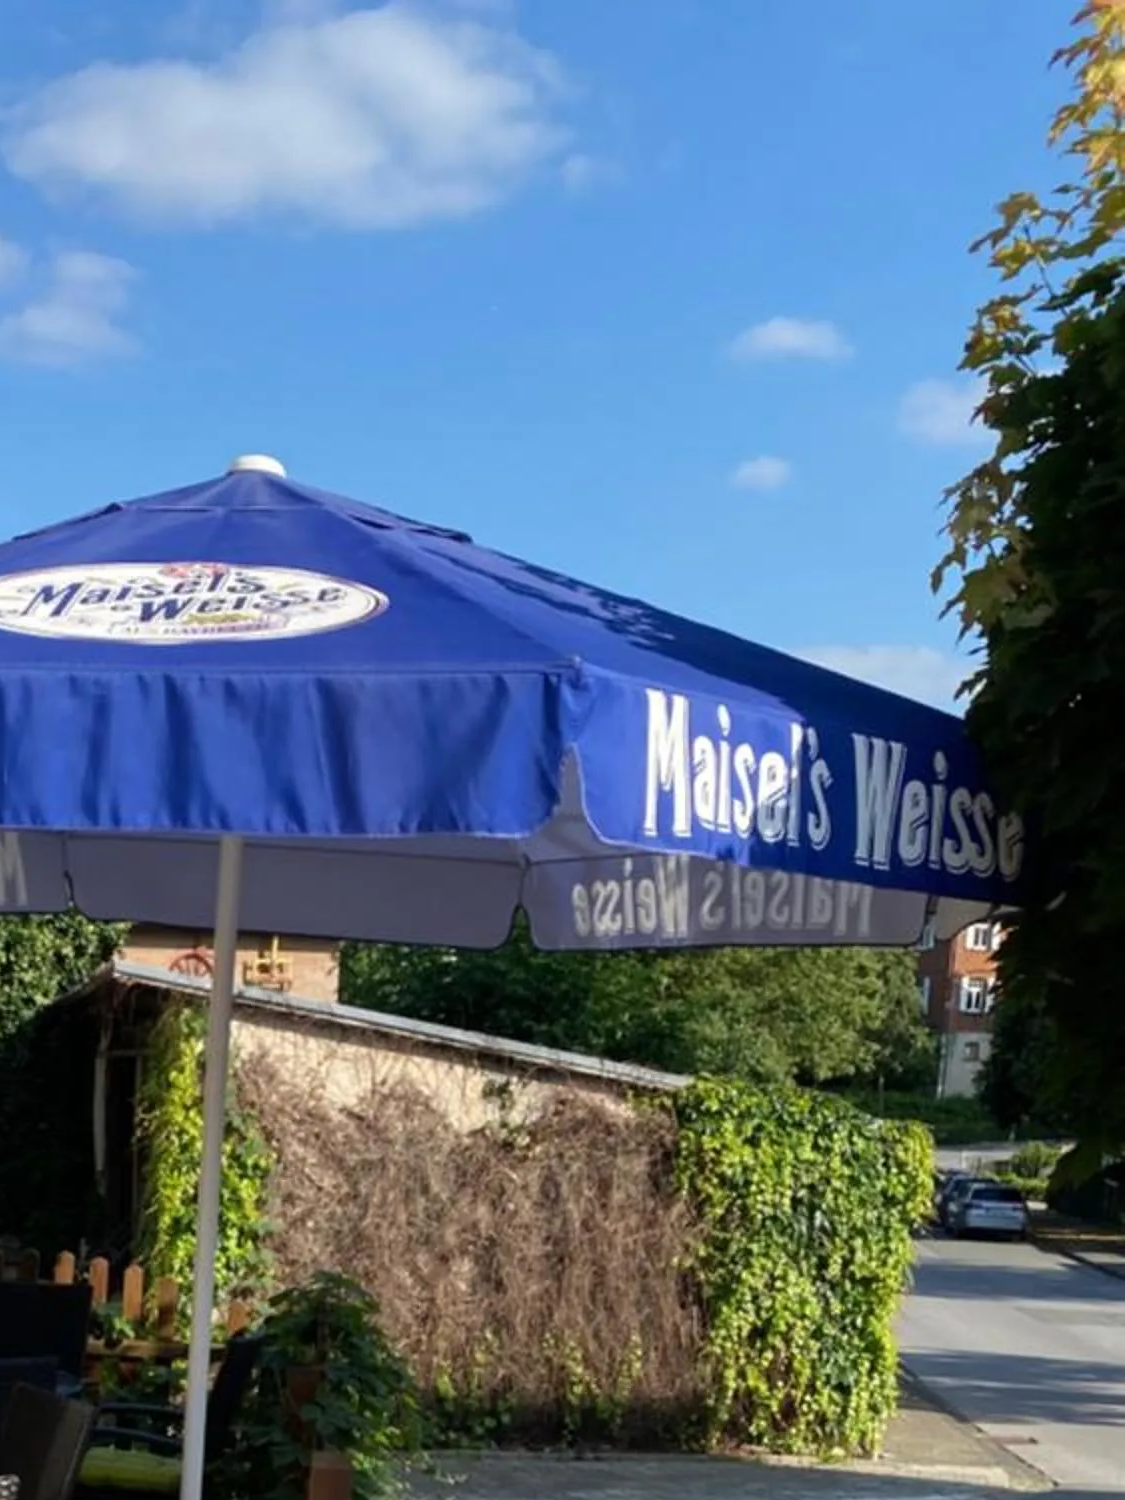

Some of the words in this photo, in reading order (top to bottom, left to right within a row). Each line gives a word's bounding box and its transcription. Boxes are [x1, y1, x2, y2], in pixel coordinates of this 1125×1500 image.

[138, 587, 346, 622] Weisse
[644, 687, 834, 850] Maisel's
[852, 732, 1026, 882] Weisse
